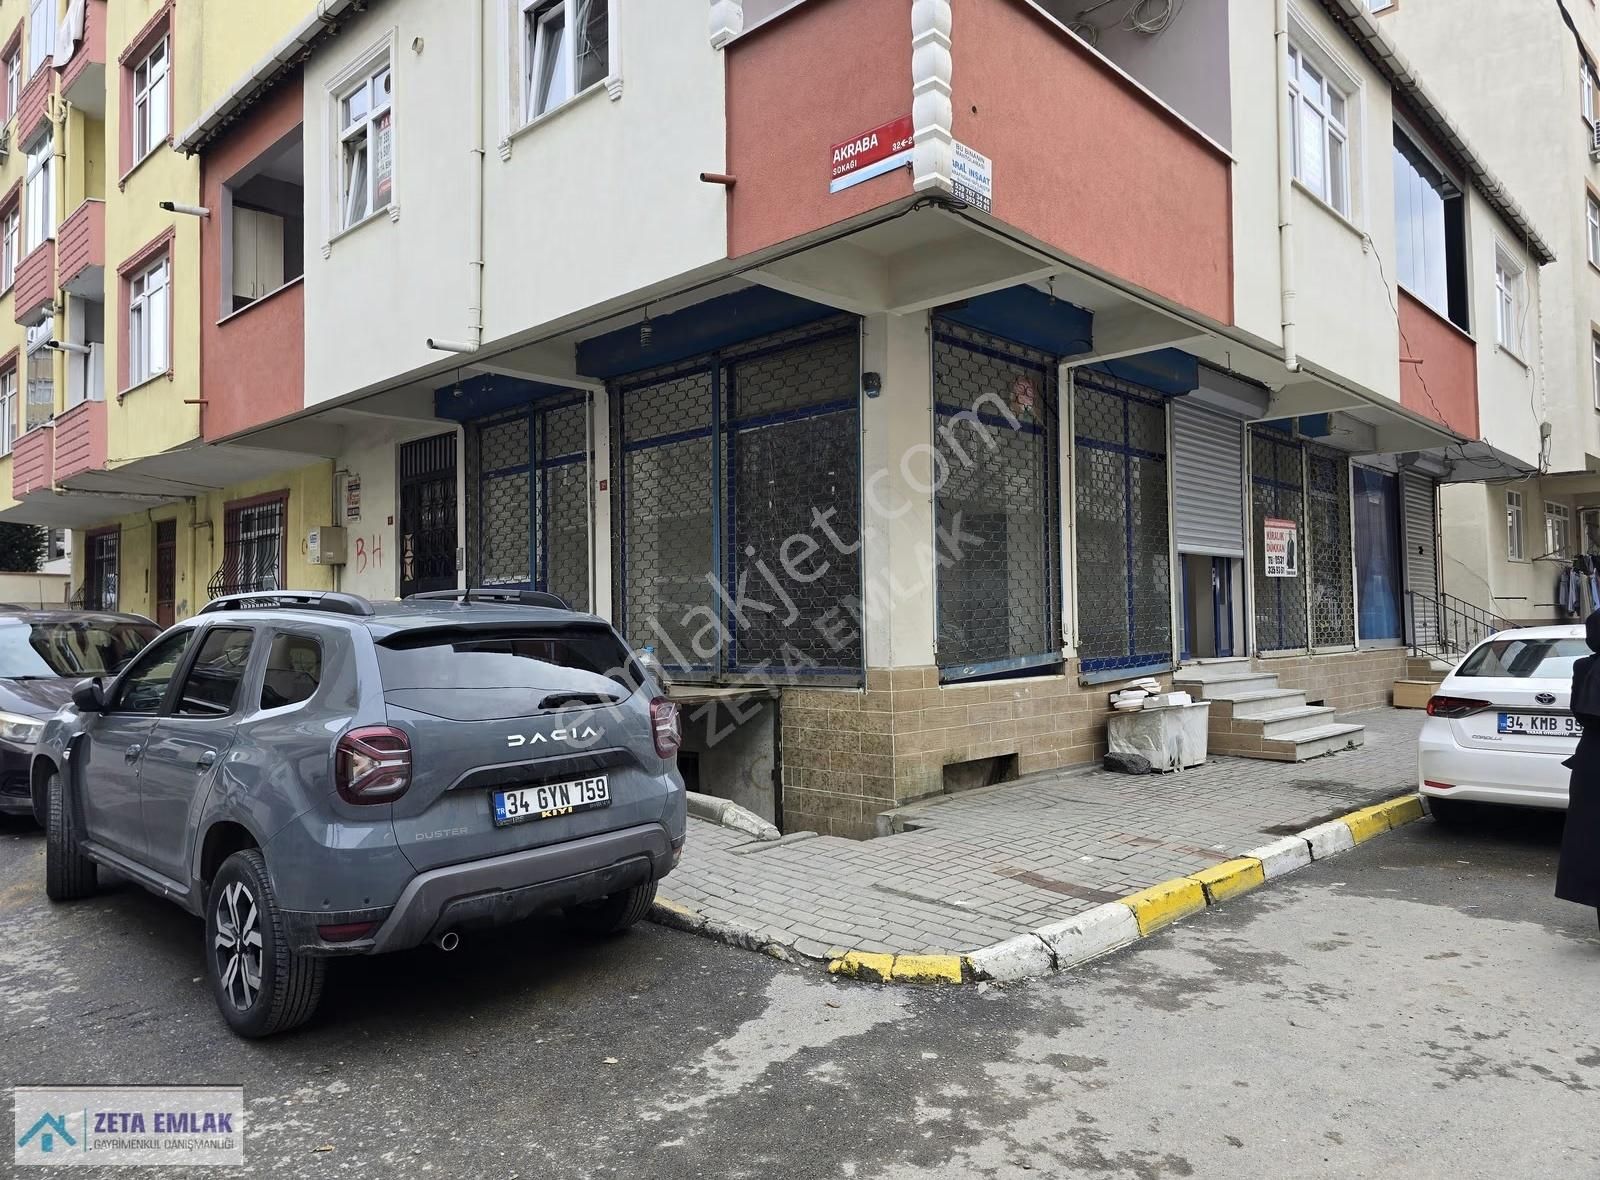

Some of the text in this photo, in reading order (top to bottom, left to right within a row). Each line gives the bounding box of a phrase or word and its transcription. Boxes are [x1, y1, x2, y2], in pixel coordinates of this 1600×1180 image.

[833, 133, 878, 164] AKRABA
[892, 142, 902, 151] 32
[1507, 716, 1524, 729] 34
[1531, 716, 1558, 731] KMB
[1565, 718, 1583, 732] 99
[507, 726, 597, 747] DACIA
[496, 807, 506, 815] TR
[506, 791, 530, 815] 34
[536, 784, 571, 810] GYN
[574, 778, 606, 803] 759
[541, 806, 573, 818] KIYI
[415, 826, 469, 841] DUSTER
